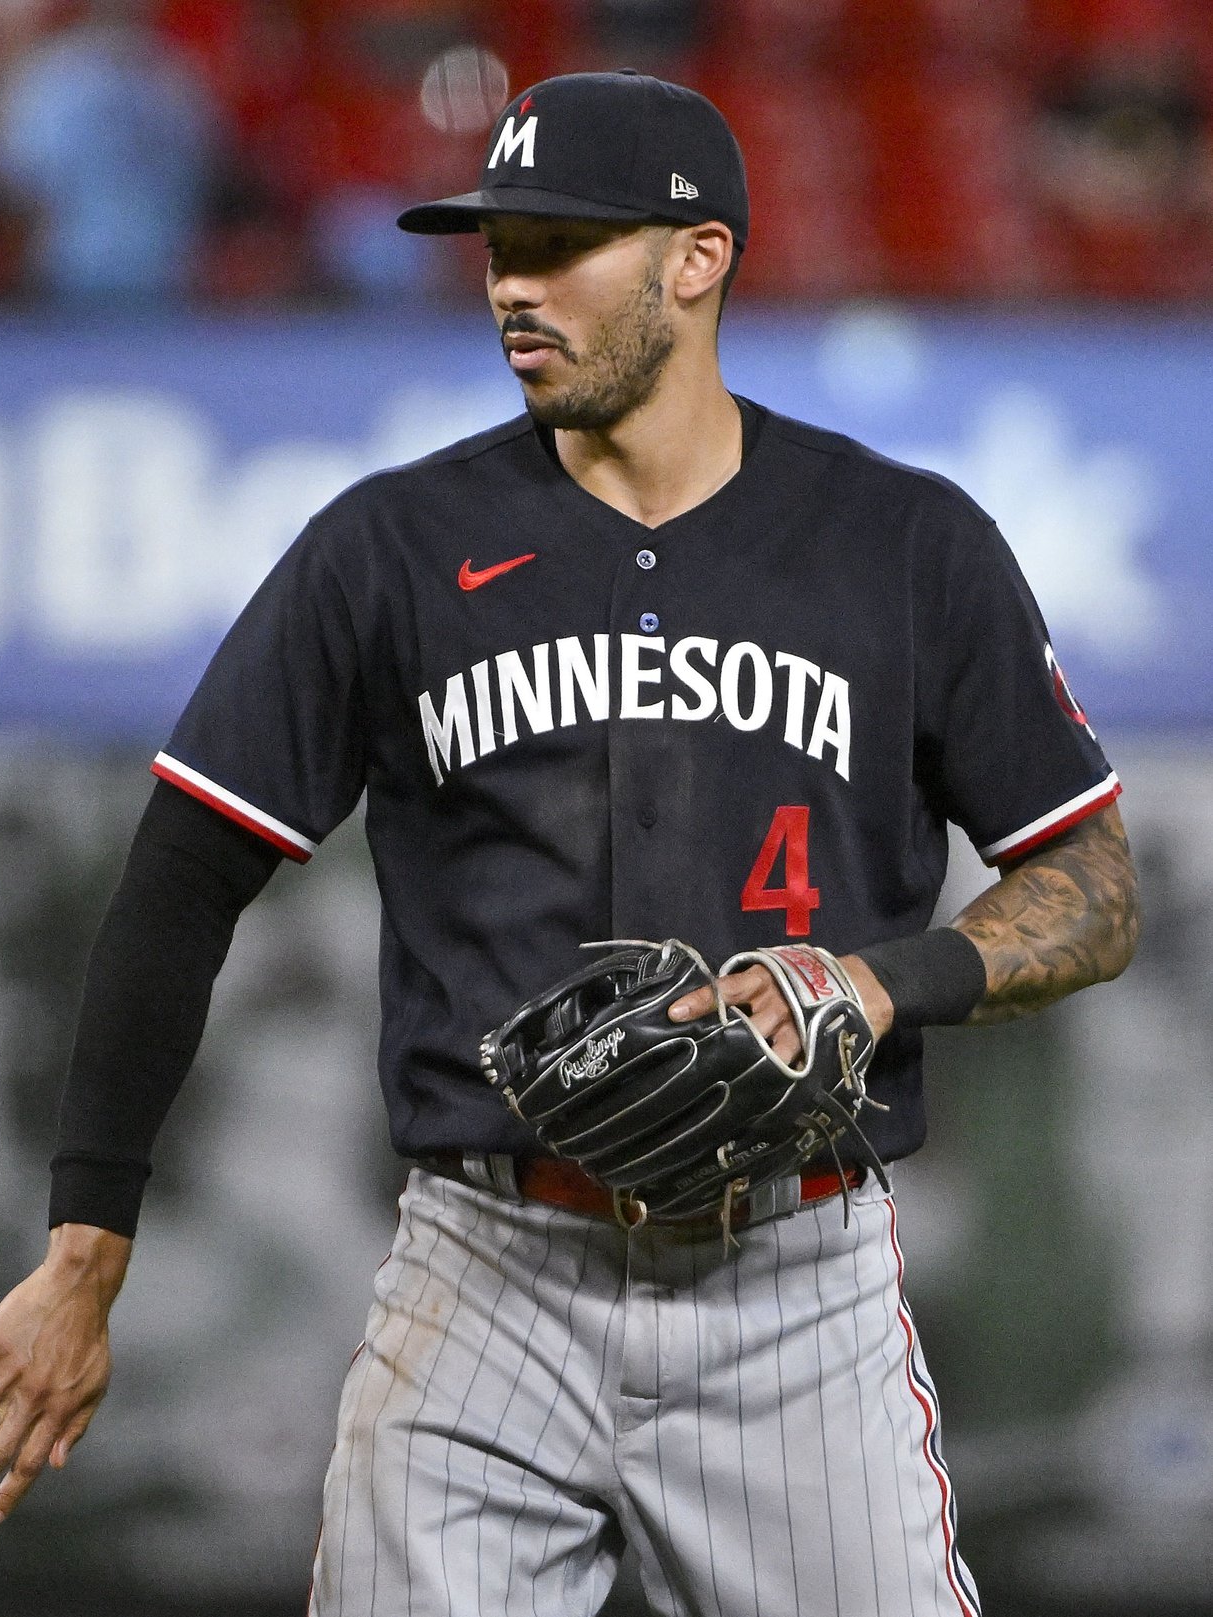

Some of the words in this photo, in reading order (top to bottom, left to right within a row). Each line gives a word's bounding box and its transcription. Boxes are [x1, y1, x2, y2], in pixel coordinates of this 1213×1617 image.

[488, 115, 539, 169] M
[418, 632, 852, 786] MINNESOTA
[741, 805, 821, 938] 4
[559, 1027, 626, 1088] Rawlings
